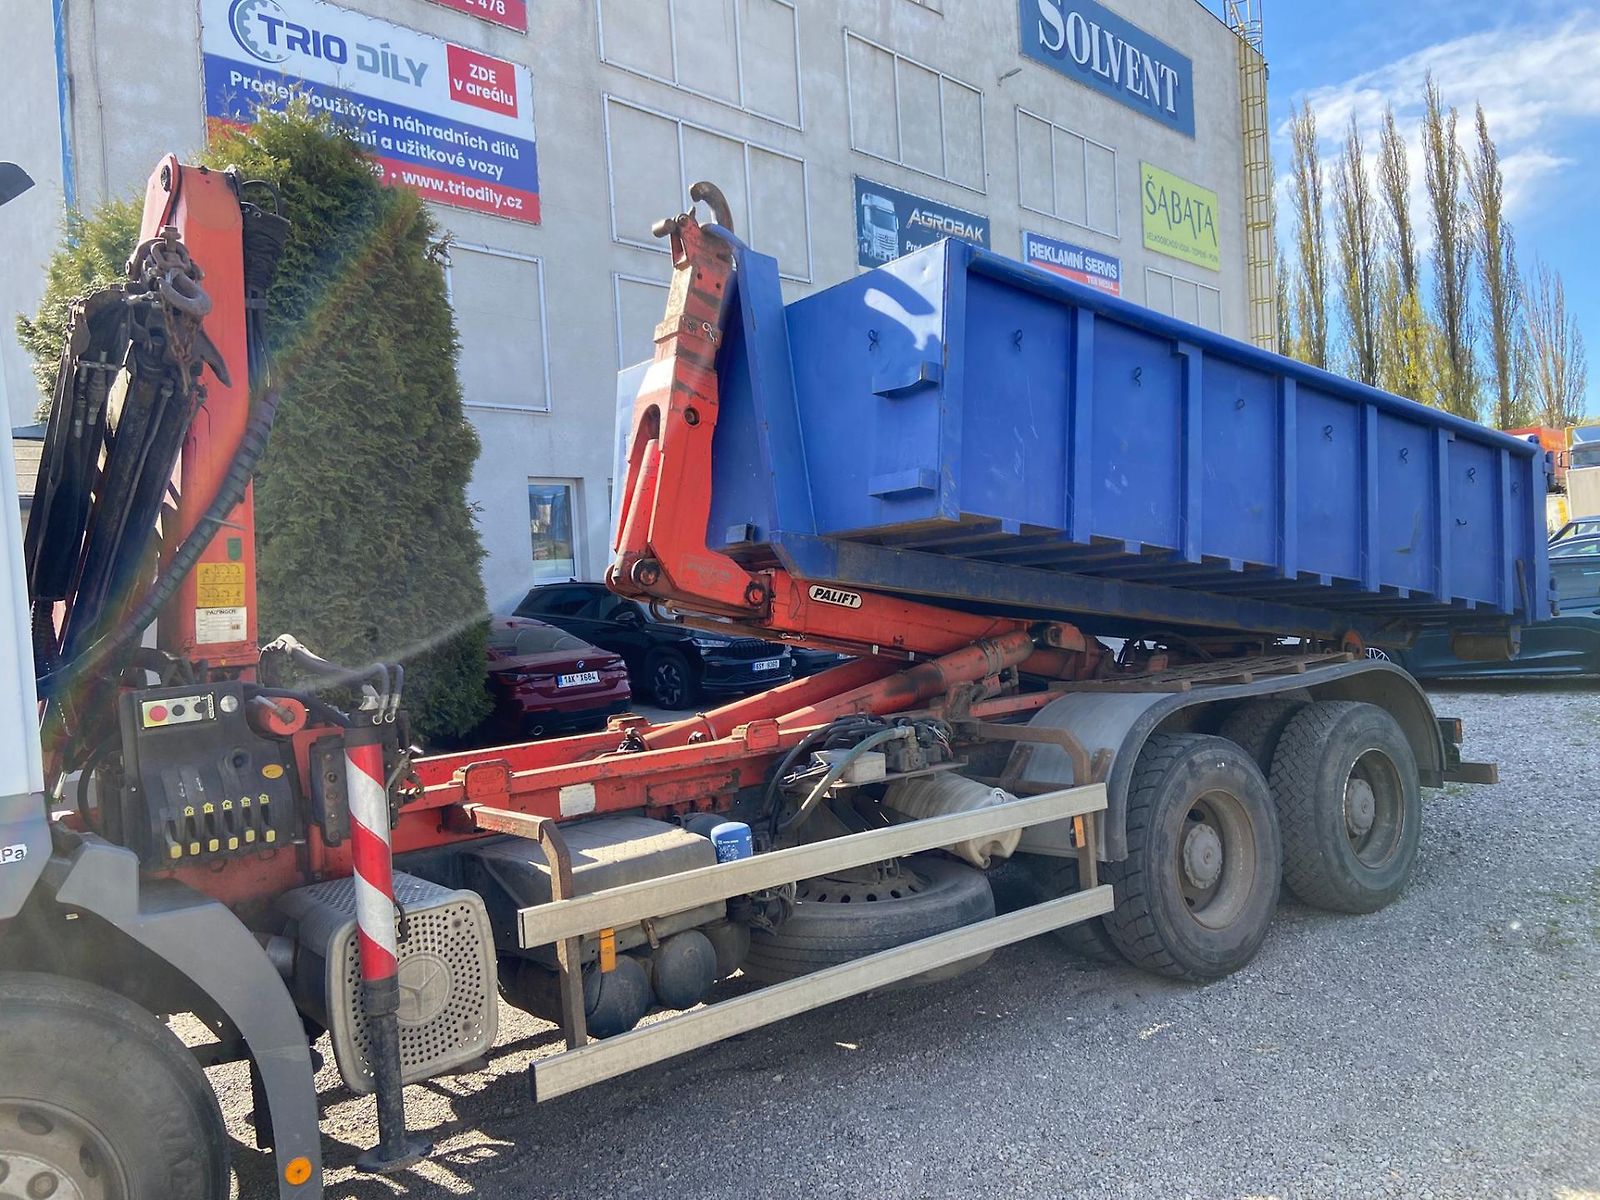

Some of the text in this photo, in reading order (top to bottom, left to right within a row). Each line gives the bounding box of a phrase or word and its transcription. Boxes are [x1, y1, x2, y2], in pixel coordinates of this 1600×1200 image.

[257, 13, 429, 88] TRIO DÍLY
[1038, 0, 1179, 113] SOLVENT
[453, 78, 514, 107] v areálu
[469, 63, 497, 84] ZDE
[393, 115, 488, 151] náhradních
[491, 141, 520, 160] dílů
[381, 137, 504, 181] a užitkové vozy
[401, 171, 523, 209] www.triodily.cz
[906, 208, 984, 242] AGROBAK
[1145, 174, 1218, 247] ŠABATA
[1029, 241, 1118, 279] REKLAMNÍ SERVIS
[813, 588, 858, 605] PALIFT
